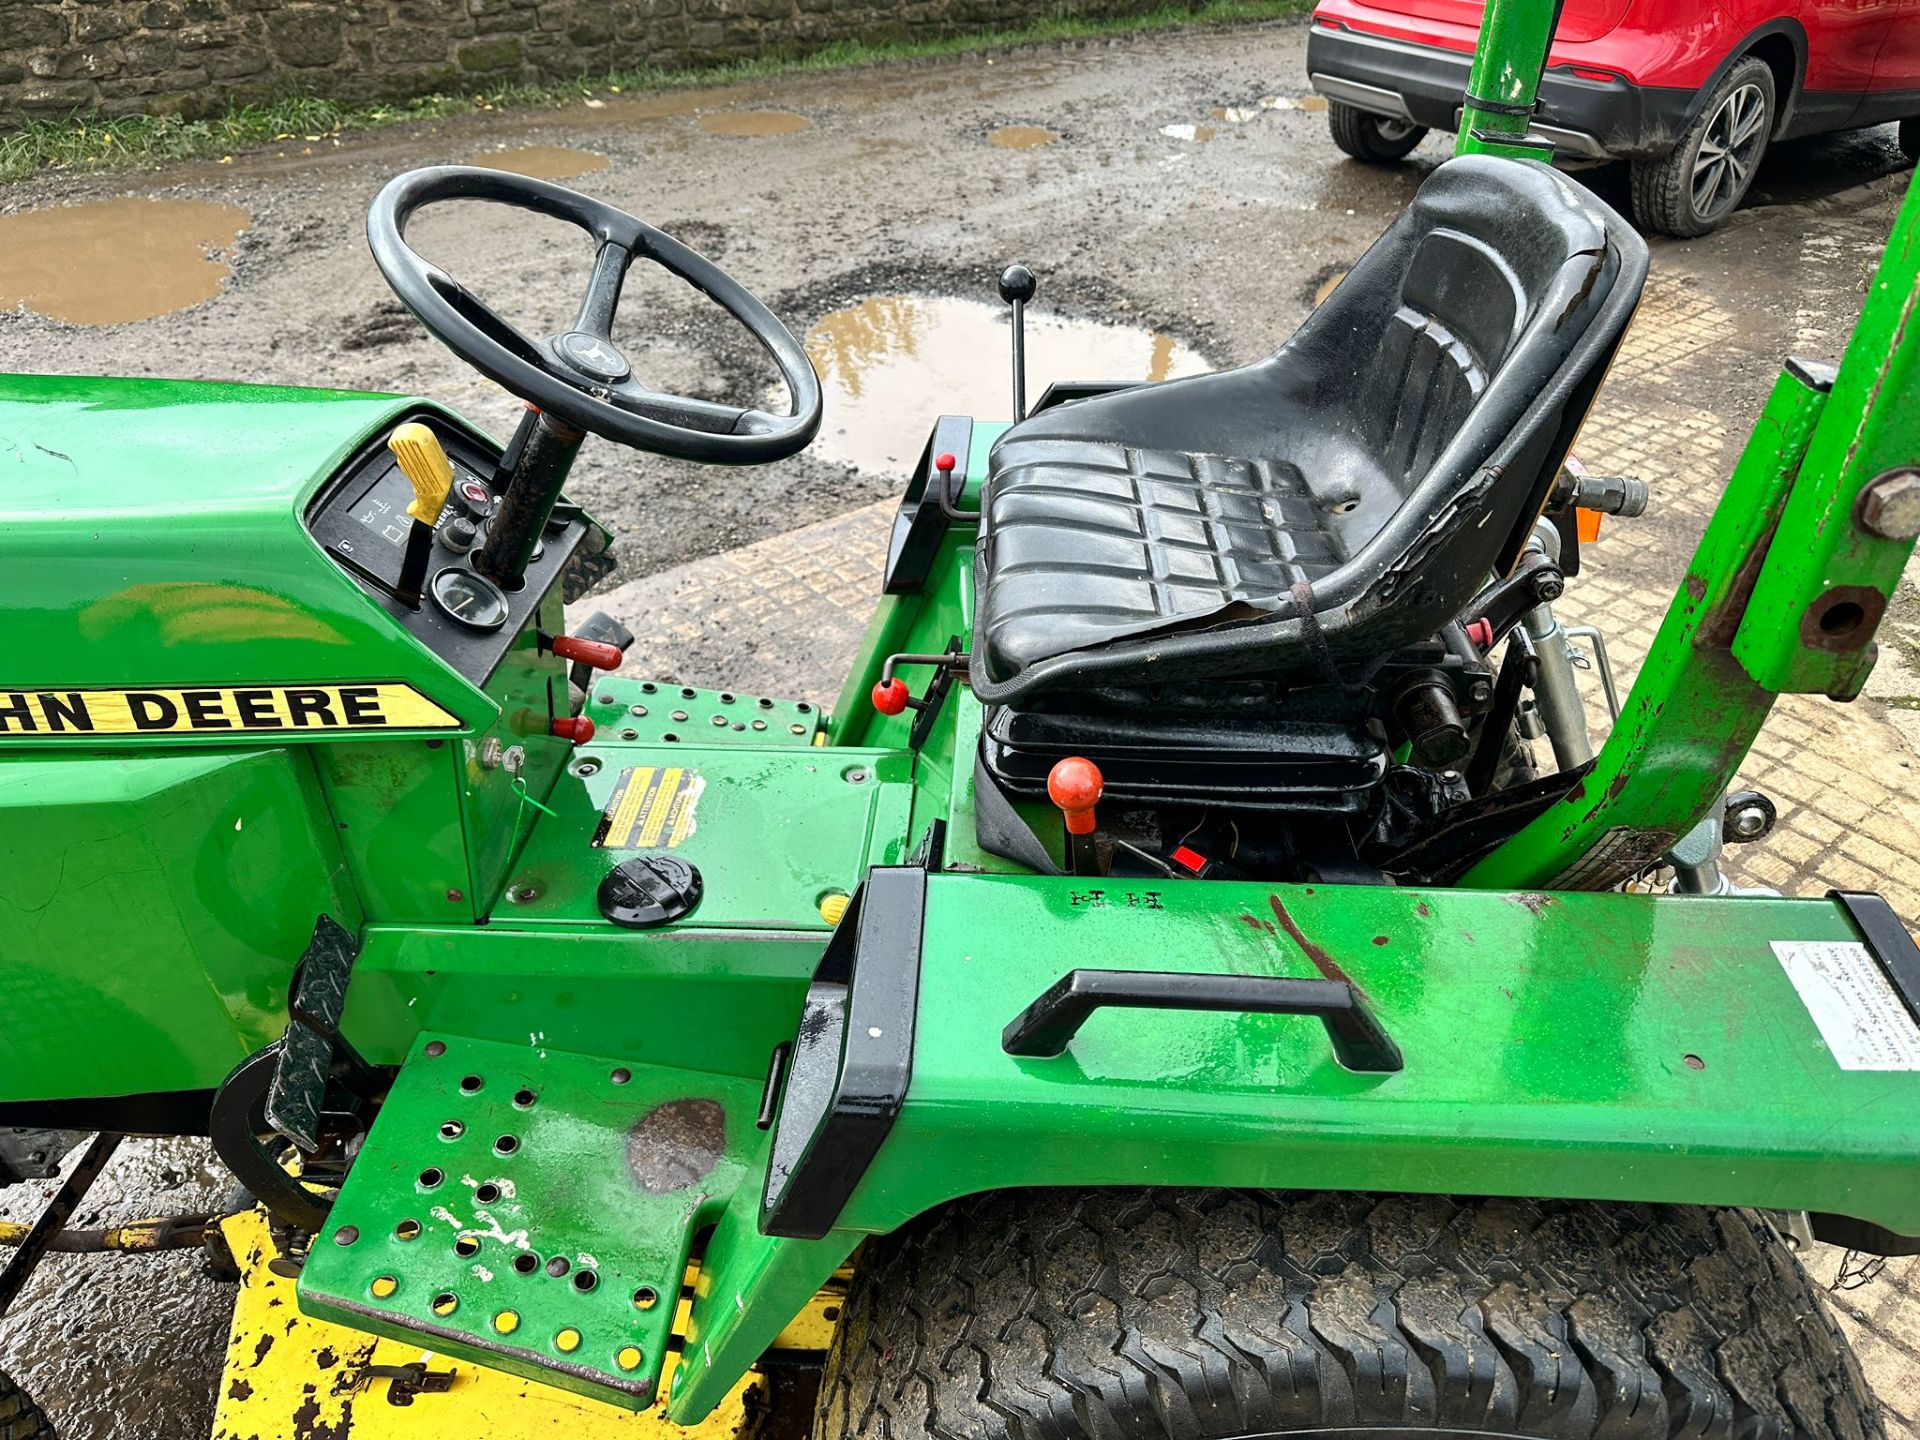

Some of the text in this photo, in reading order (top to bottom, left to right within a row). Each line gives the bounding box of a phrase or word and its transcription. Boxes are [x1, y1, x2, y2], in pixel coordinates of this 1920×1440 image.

[127, 687, 386, 729] DEERE
[608, 788, 625, 815] CAUTION
[638, 786, 658, 820] ATTENTION
[1827, 948, 1905, 1063] Sales Spares Service
